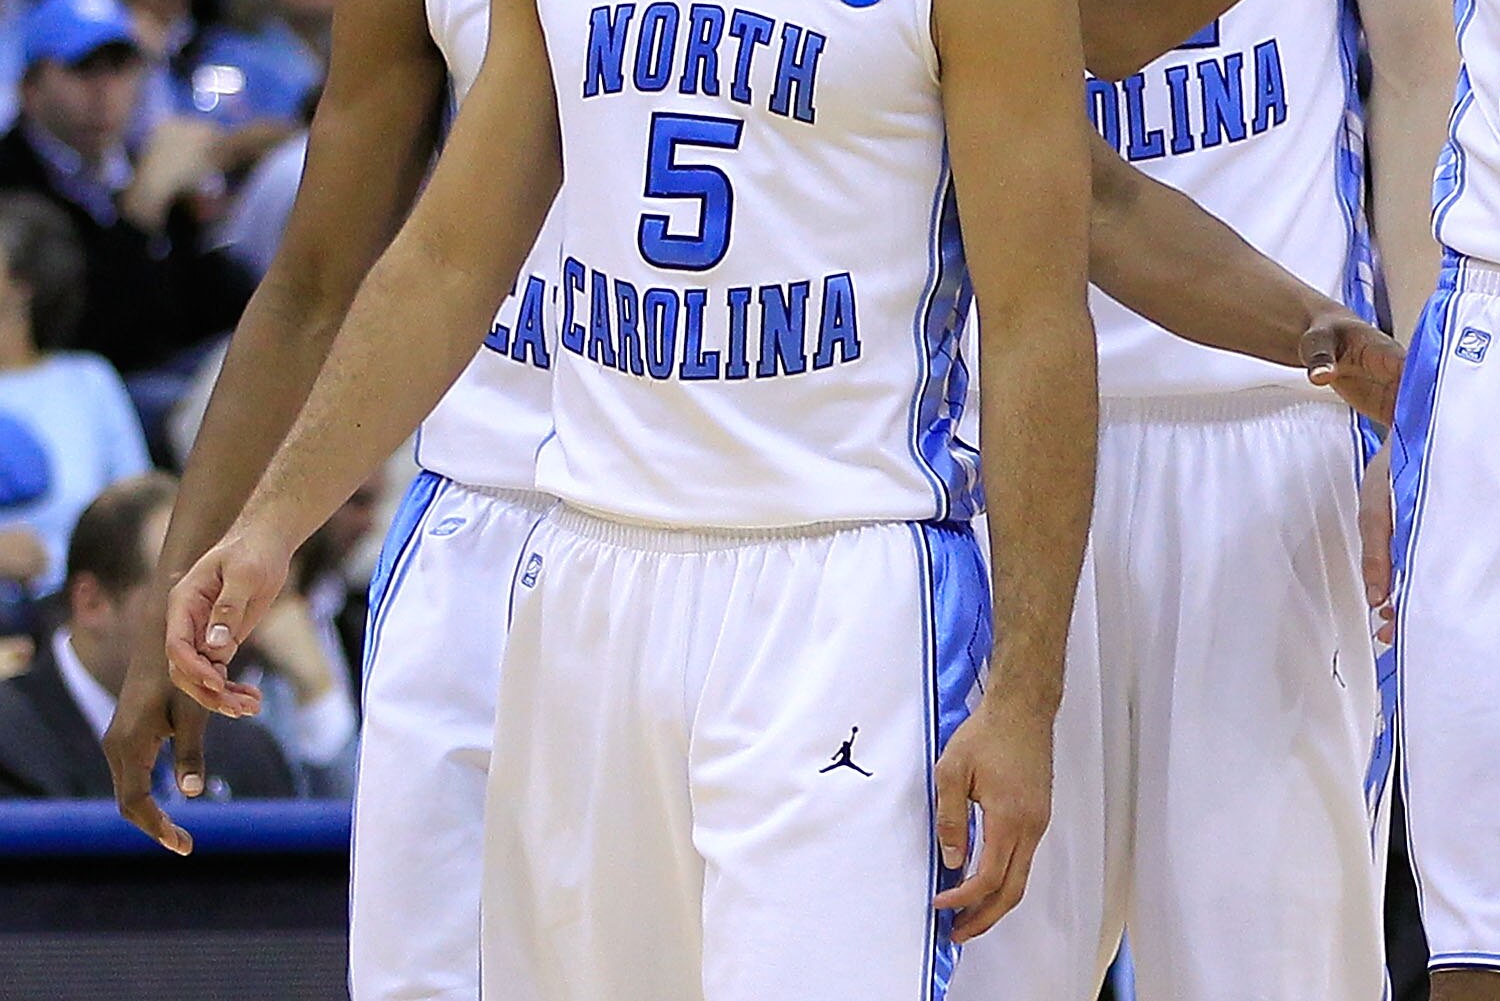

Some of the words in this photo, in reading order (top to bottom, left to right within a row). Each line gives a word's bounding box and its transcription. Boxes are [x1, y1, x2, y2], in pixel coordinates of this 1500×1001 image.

[583, 2, 825, 124] NORTH
[637, 111, 744, 272] 5
[561, 256, 861, 381] CAROLINA
